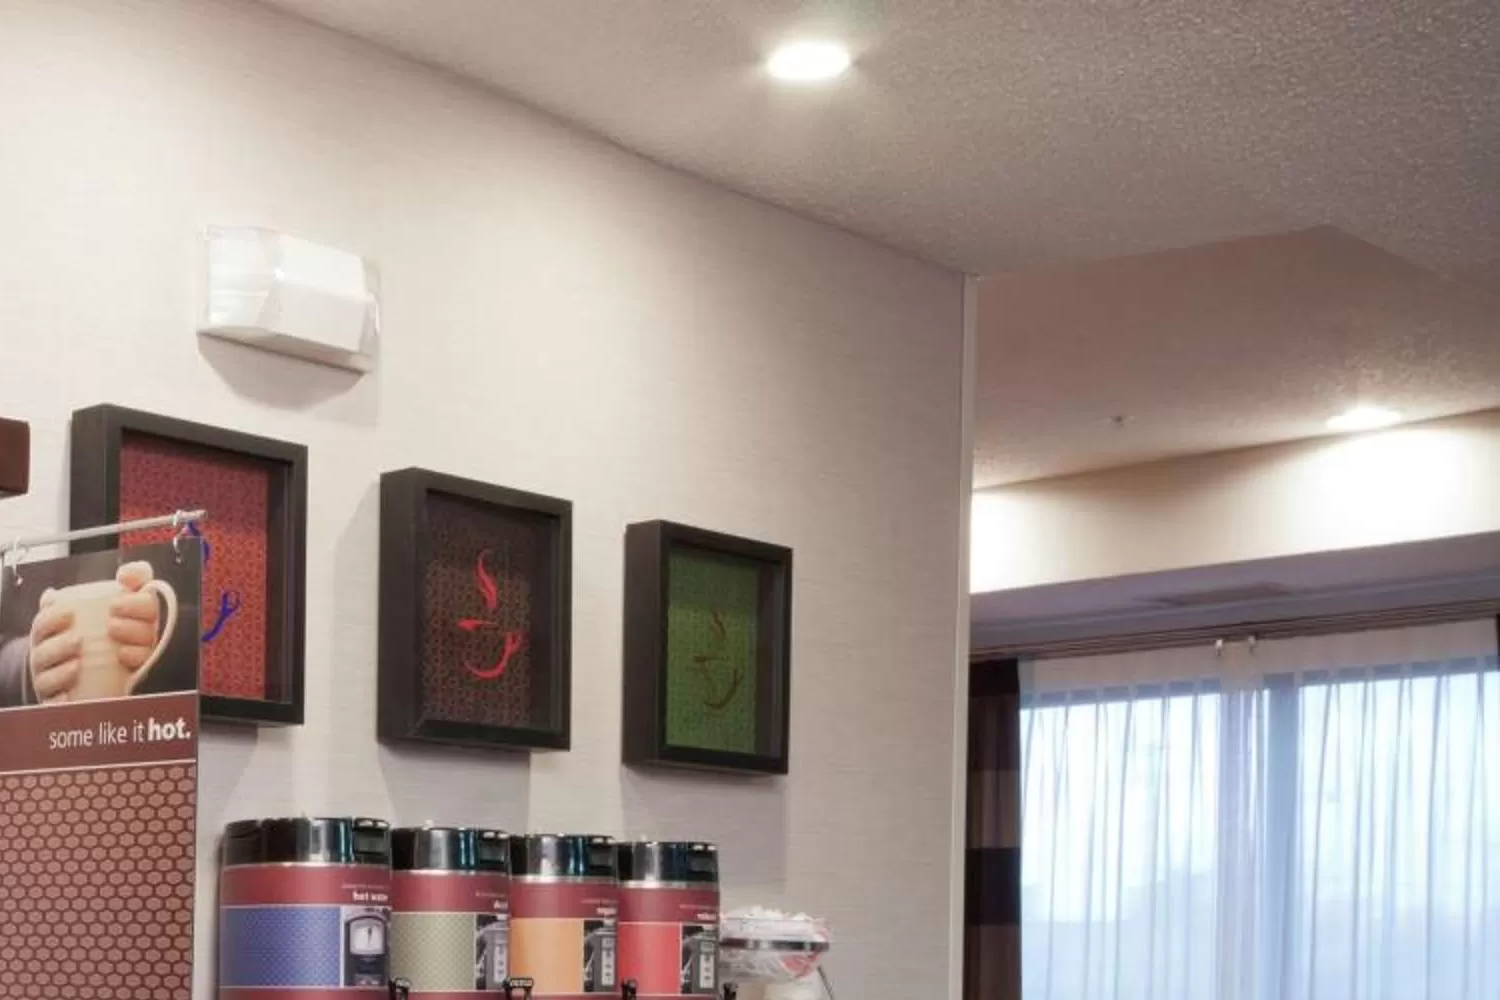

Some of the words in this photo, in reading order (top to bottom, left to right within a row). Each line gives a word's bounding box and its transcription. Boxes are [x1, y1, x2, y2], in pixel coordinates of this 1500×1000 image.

[49, 729, 93, 750] some
[99, 720, 128, 745] like
[132, 718, 145, 743] it
[148, 716, 191, 741] hot.
